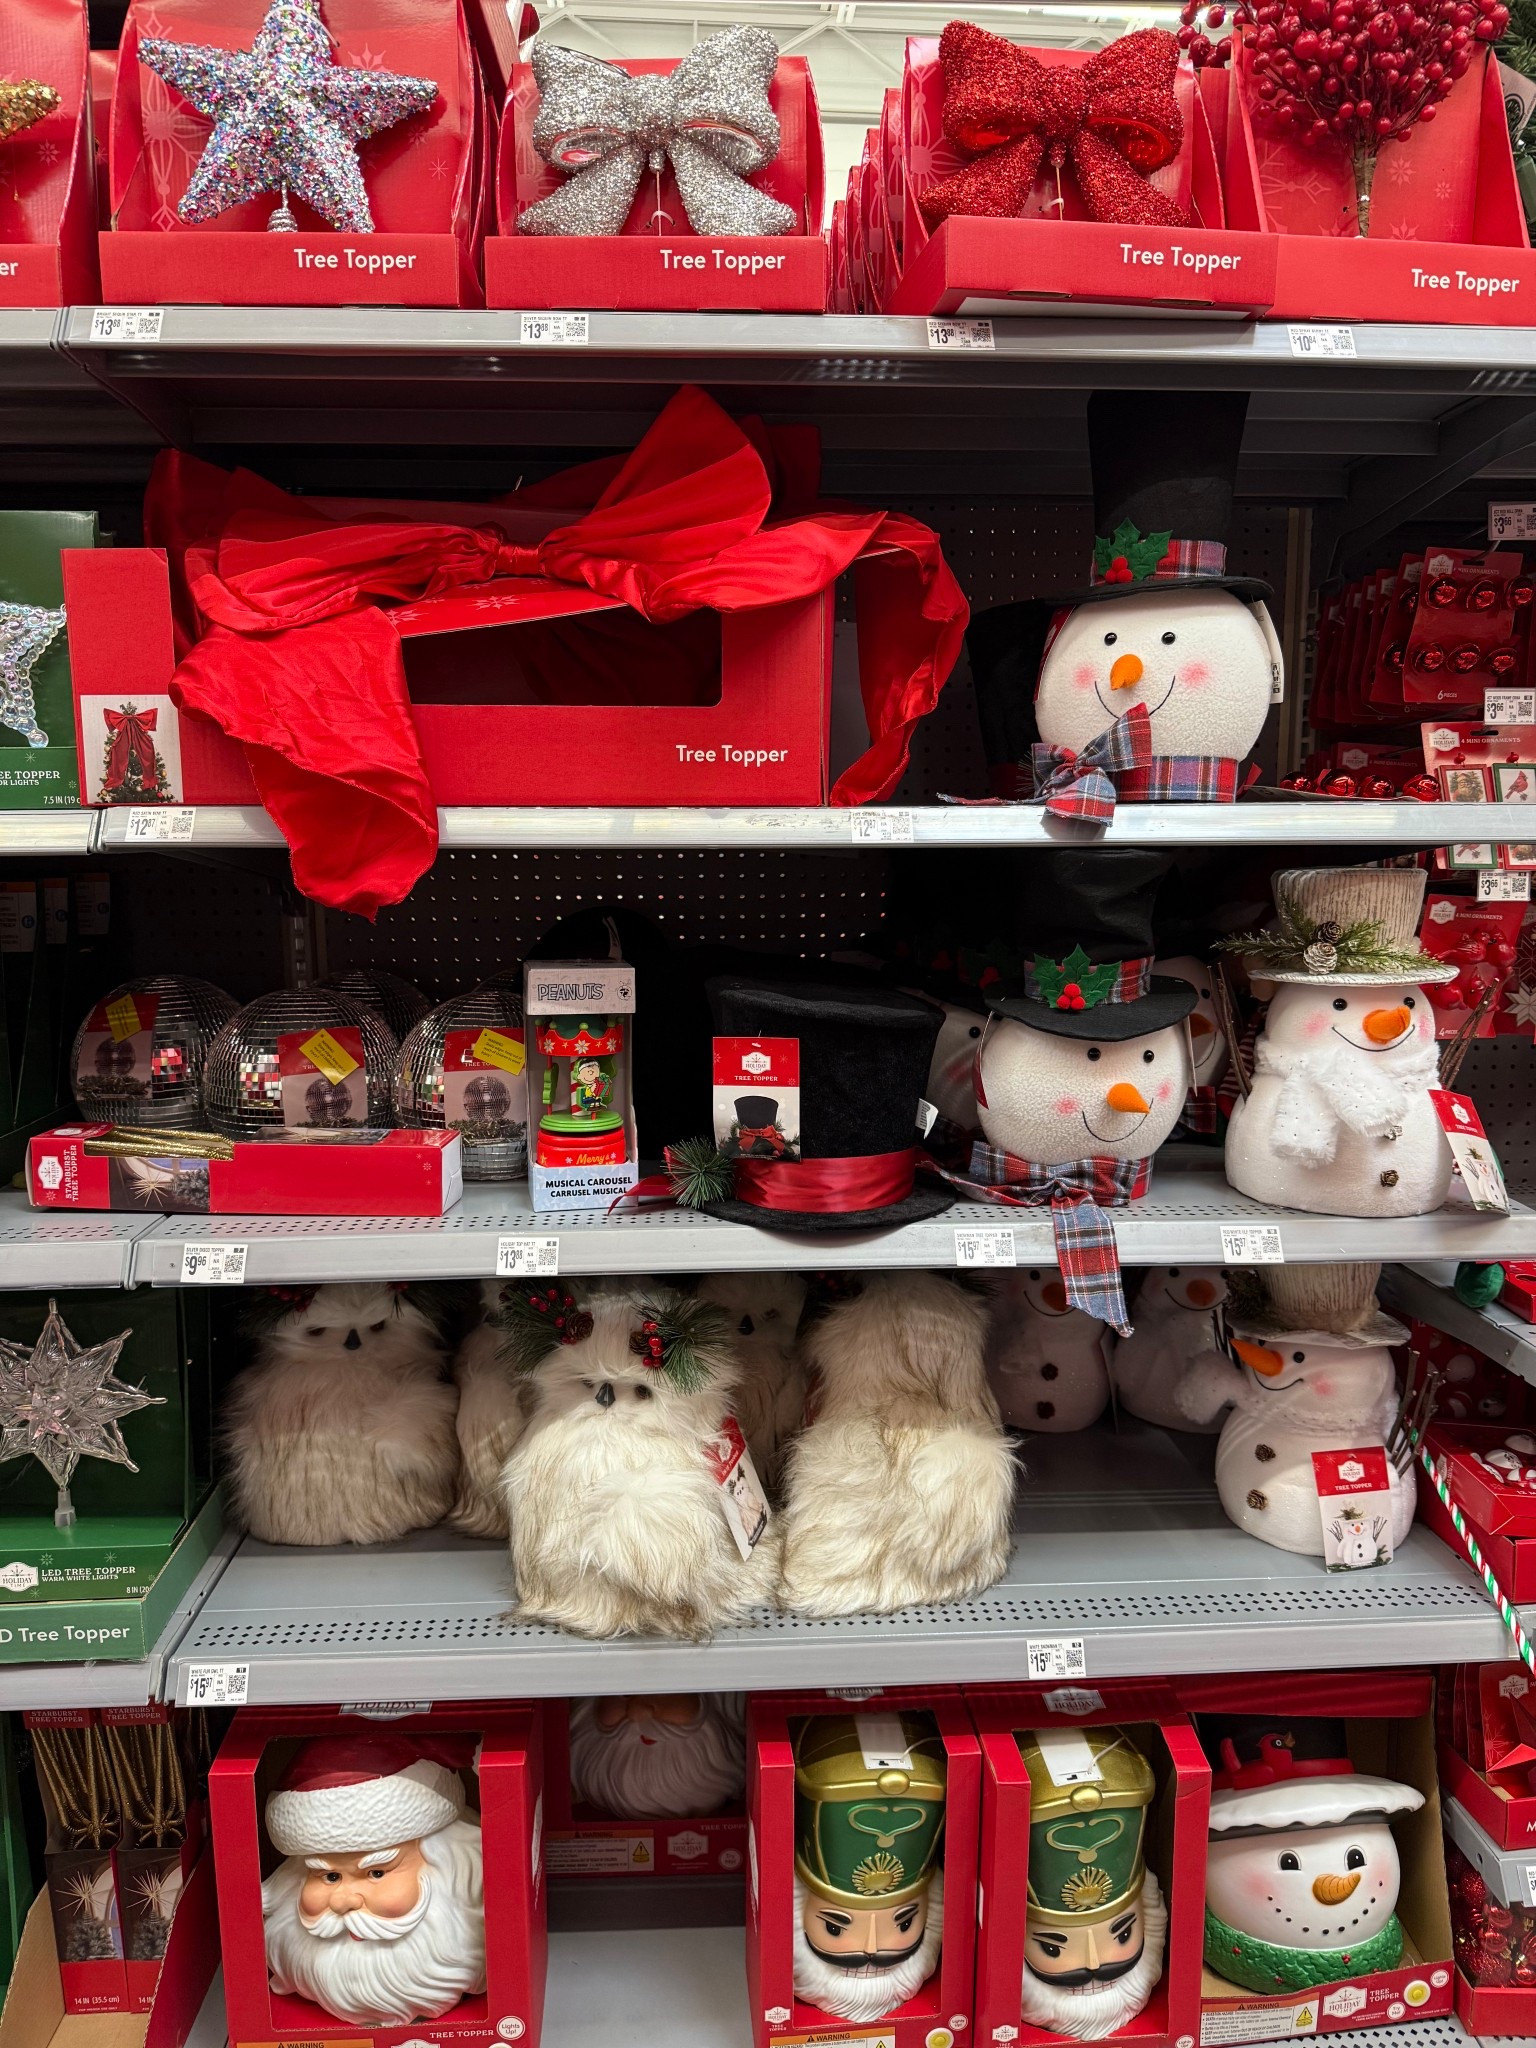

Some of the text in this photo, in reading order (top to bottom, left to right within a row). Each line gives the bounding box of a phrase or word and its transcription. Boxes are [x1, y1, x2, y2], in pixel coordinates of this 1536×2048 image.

[294, 248, 417, 274] Tree Topper
[660, 249, 786, 275] Tree Topper
[1120, 244, 1241, 274] Tree Topper
[1412, 268, 1520, 296] Tree Topper
[1438, 690, 1444, 700] 6
[676, 745, 788, 767] Tree Topper
[14, 771, 60, 779] TOPPER
[44, 796, 54, 804] 7.5
[55, 796, 62, 804] IN
[538, 983, 604, 1001] PEANUTS
[1439, 1028, 1445, 1036] 4
[576, 1154, 606, 1164] Merry
[64, 1150, 72, 1198] STARBURST
[546, 1177, 632, 1188] MUSICAL CAROUSEL
[551, 1187, 627, 1197] CARRUSEL MUSICAL
[64, 1568, 92, 1576] TREE
[94, 1566, 136, 1574] TOPPER
[18, 1627, 59, 1642] Tree
[63, 1625, 130, 1643] Topper
[1370, 1988, 1390, 1996] TREE
[1369, 1993, 1399, 2002] TOPPER
[1329, 2000, 1360, 2012] HOLIDAY
[816, 2033, 850, 2042] WARNING
